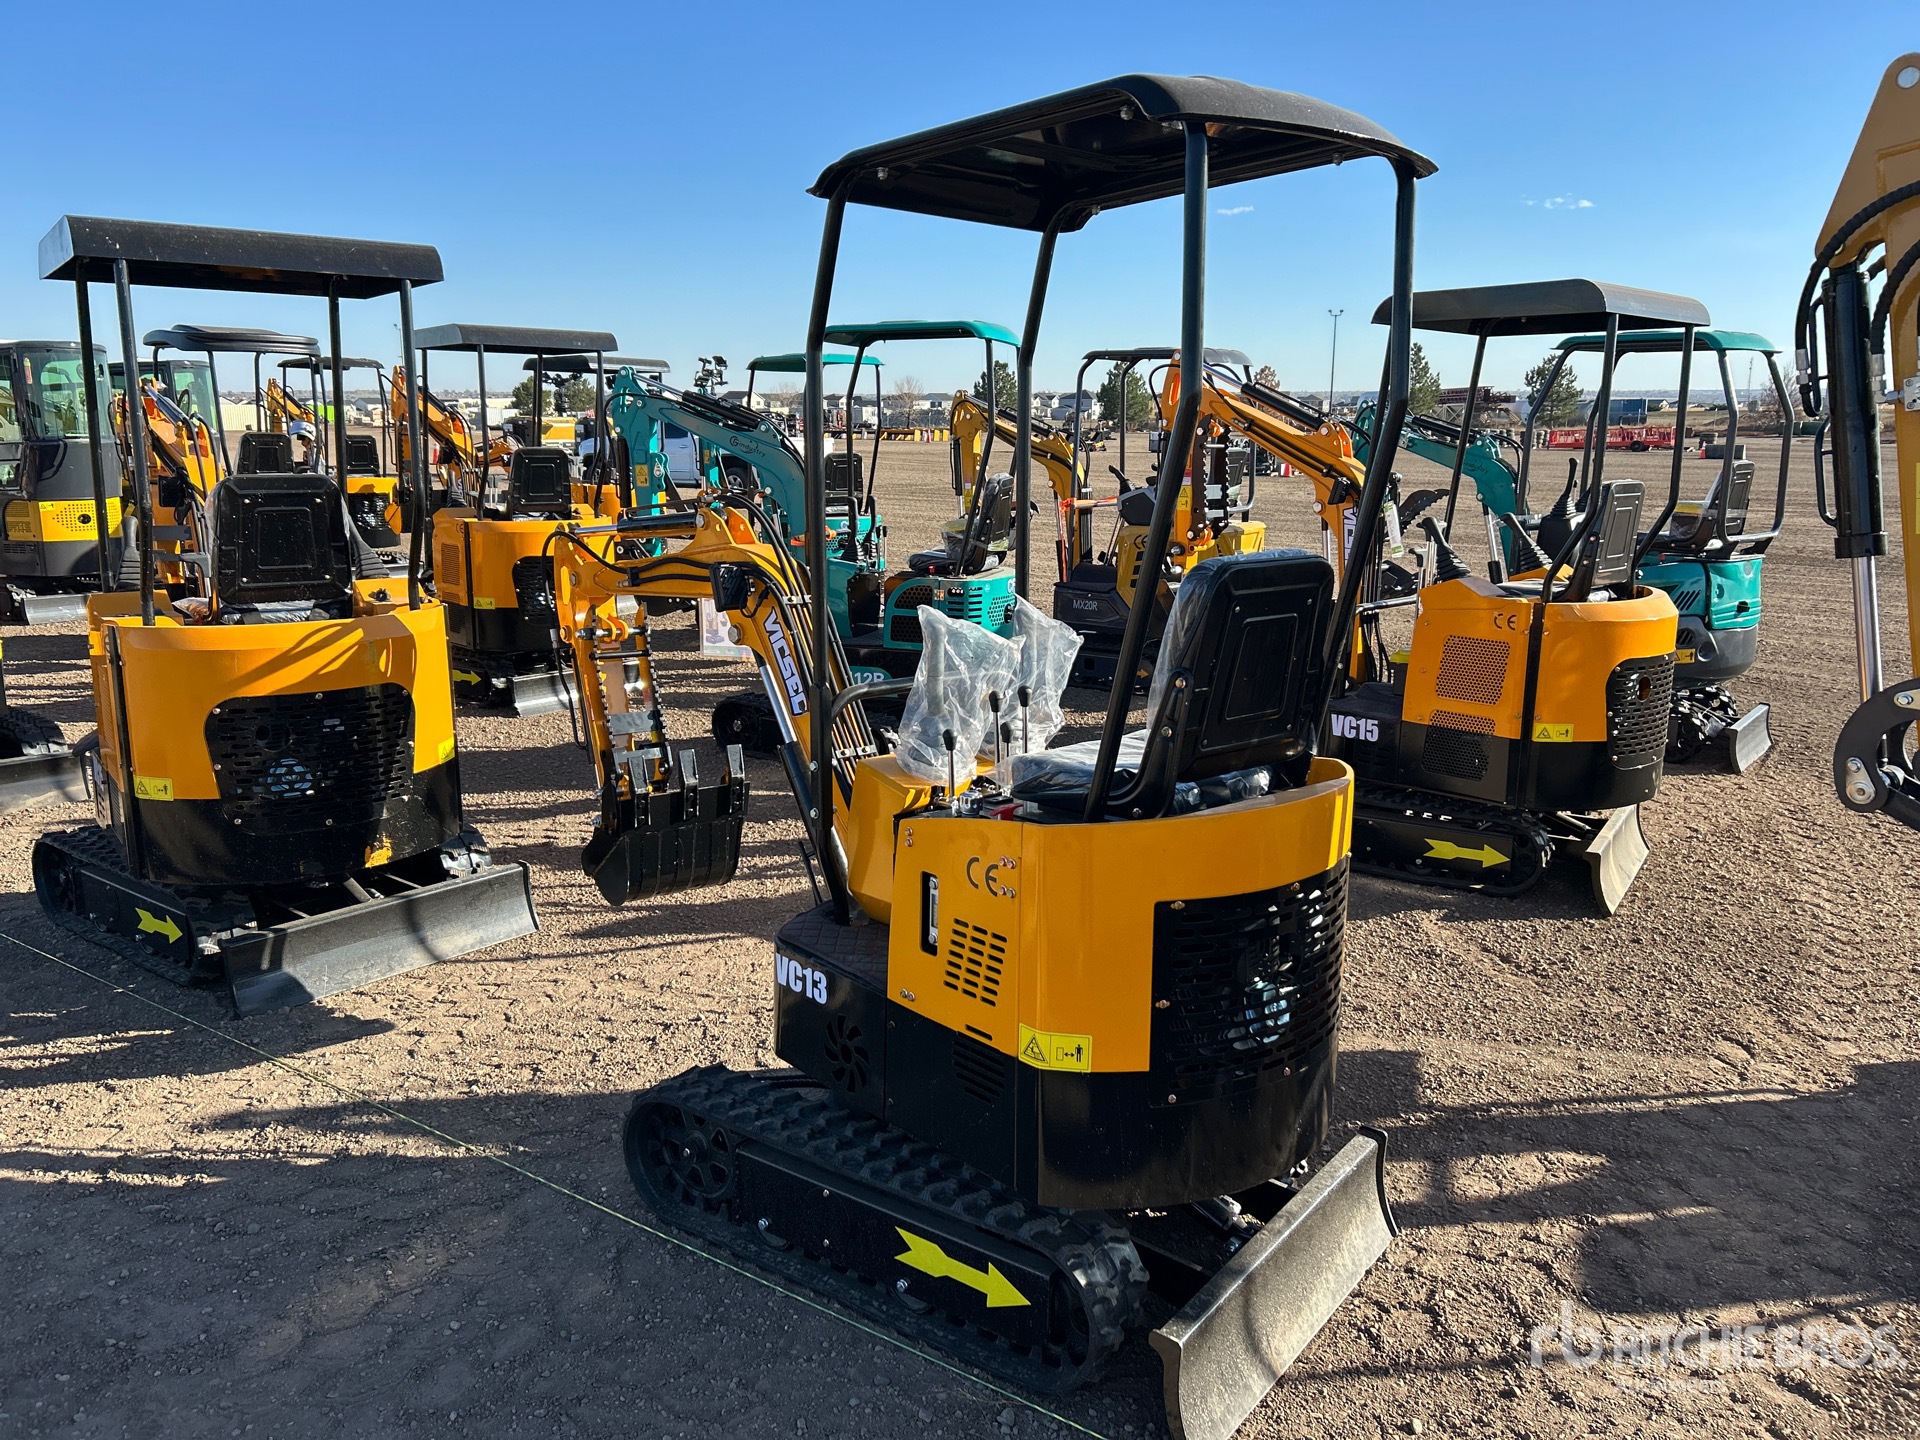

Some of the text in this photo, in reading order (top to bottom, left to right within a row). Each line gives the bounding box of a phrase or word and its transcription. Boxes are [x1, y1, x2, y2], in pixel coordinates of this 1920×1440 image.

[1072, 599, 1098, 611] MX20R
[1493, 613, 1517, 631] CE
[763, 606, 809, 716] VICSEC
[1330, 713, 1379, 742] VC15
[966, 856, 999, 897] CE
[775, 952, 828, 1005] VC13
